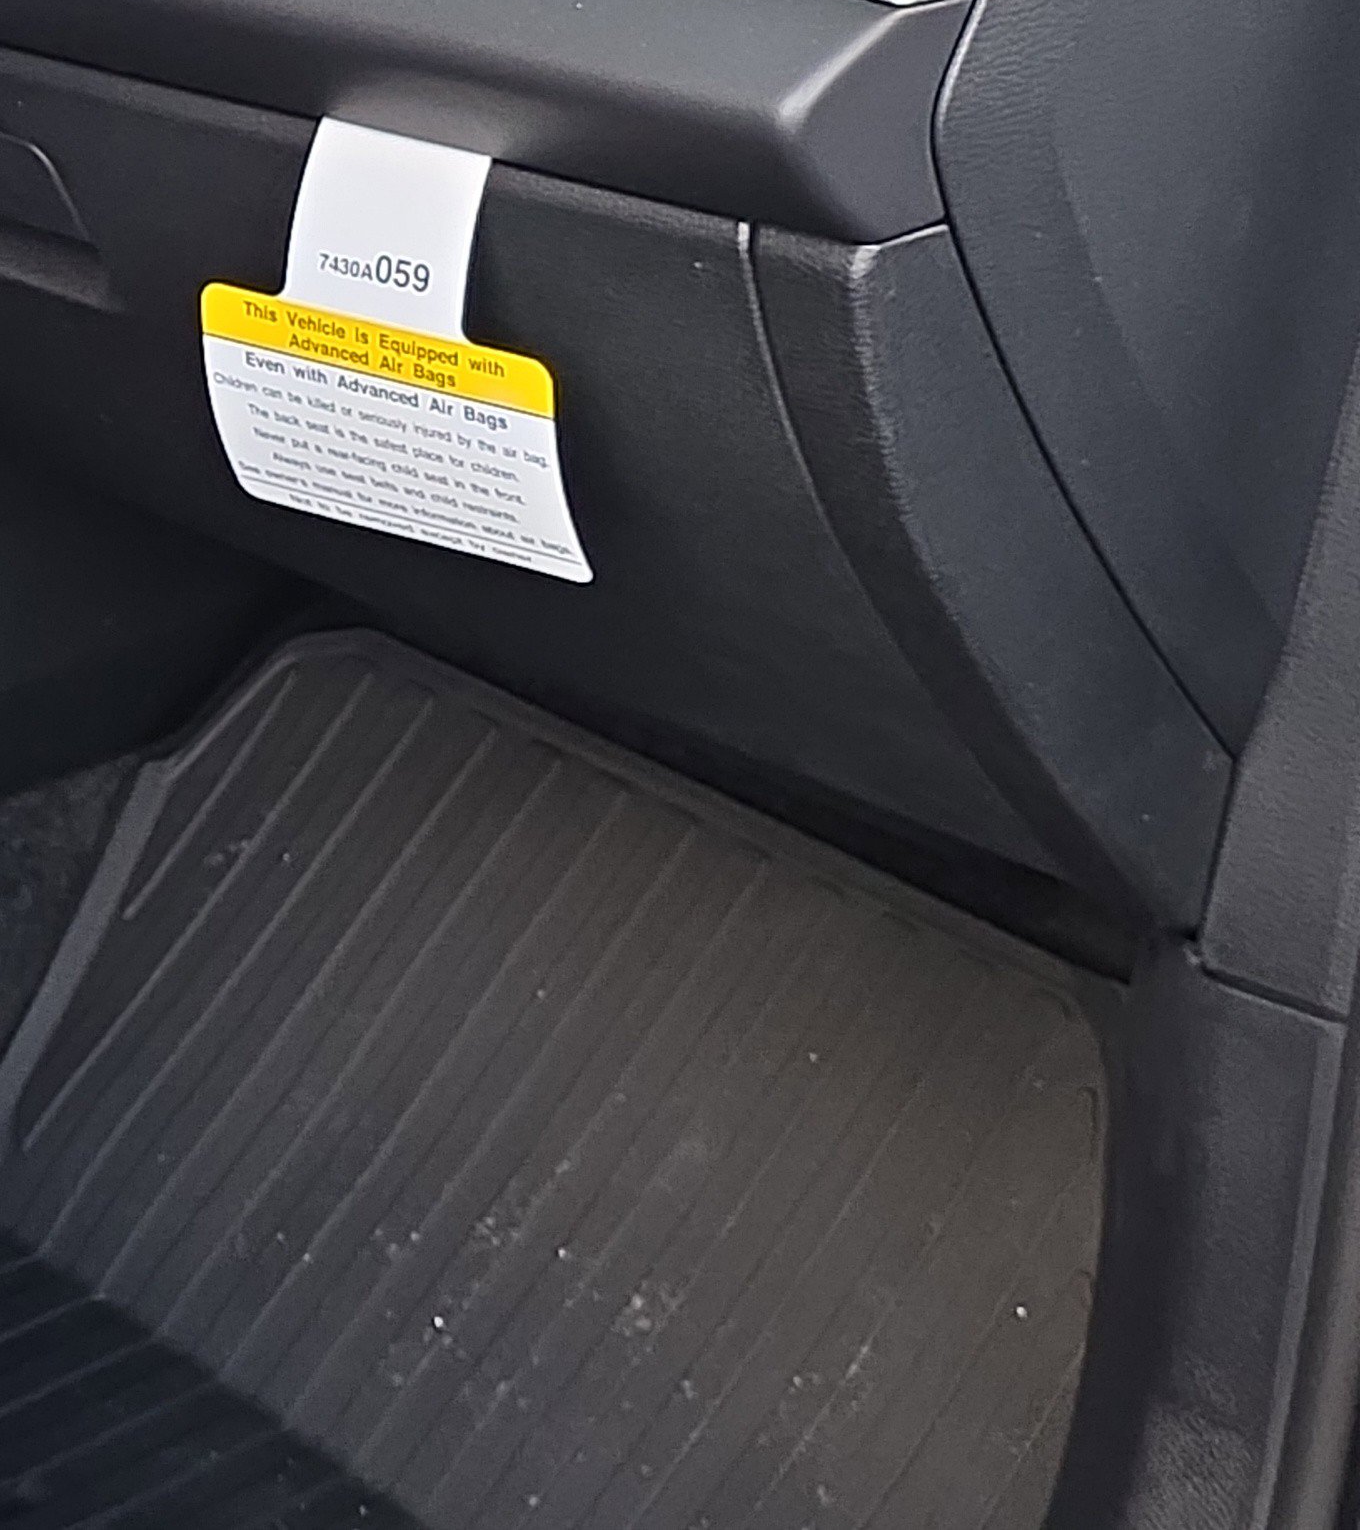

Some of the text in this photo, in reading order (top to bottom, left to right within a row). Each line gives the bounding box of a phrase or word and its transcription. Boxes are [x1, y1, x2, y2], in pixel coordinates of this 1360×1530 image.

[243, 301, 506, 378] This Vehicle is Equipped with
[289, 333, 457, 389] Advanced Air Bags
[213, 371, 259, 393] Children
[262, 387, 283, 400] can
[287, 392, 303, 405] be
[307, 396, 337, 413] killed
[341, 406, 353, 417] or
[413, 423, 453, 444] injured
[457, 434, 472, 449] by
[477, 440, 497, 454] the
[245, 351, 509, 432] Even with Advanced Air Bags
[248, 402, 270, 419] The
[349, 430, 368, 445] the
[470, 482, 491, 497] the
